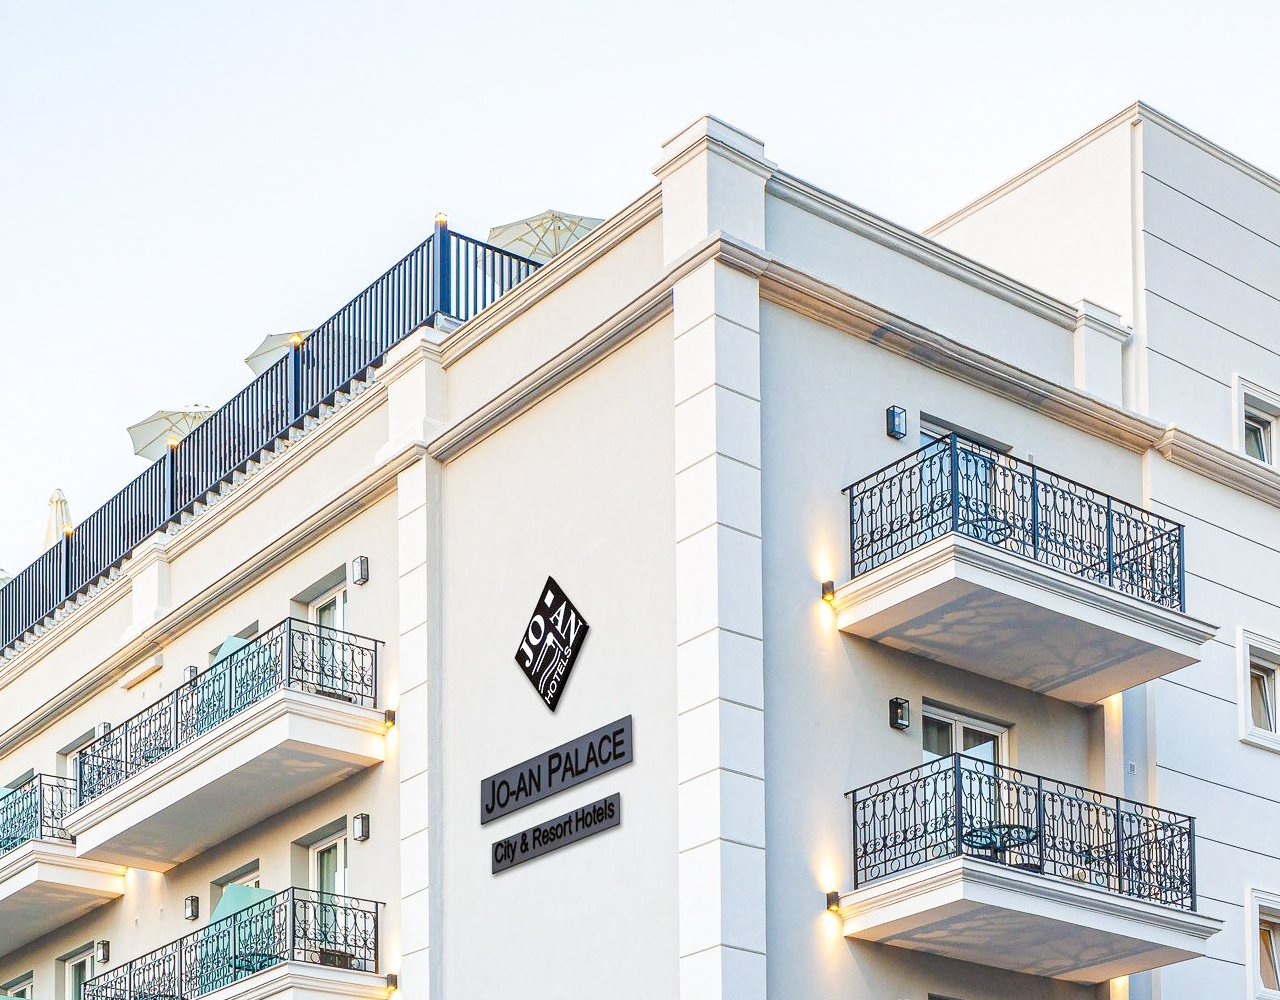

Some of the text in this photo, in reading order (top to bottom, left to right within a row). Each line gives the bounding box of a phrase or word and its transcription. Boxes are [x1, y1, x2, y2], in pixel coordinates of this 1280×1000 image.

[544, 645, 572, 705] HOTELS
[485, 727, 626, 814] JO-AN PALACE
[494, 799, 615, 864] City & Resort Hotels
